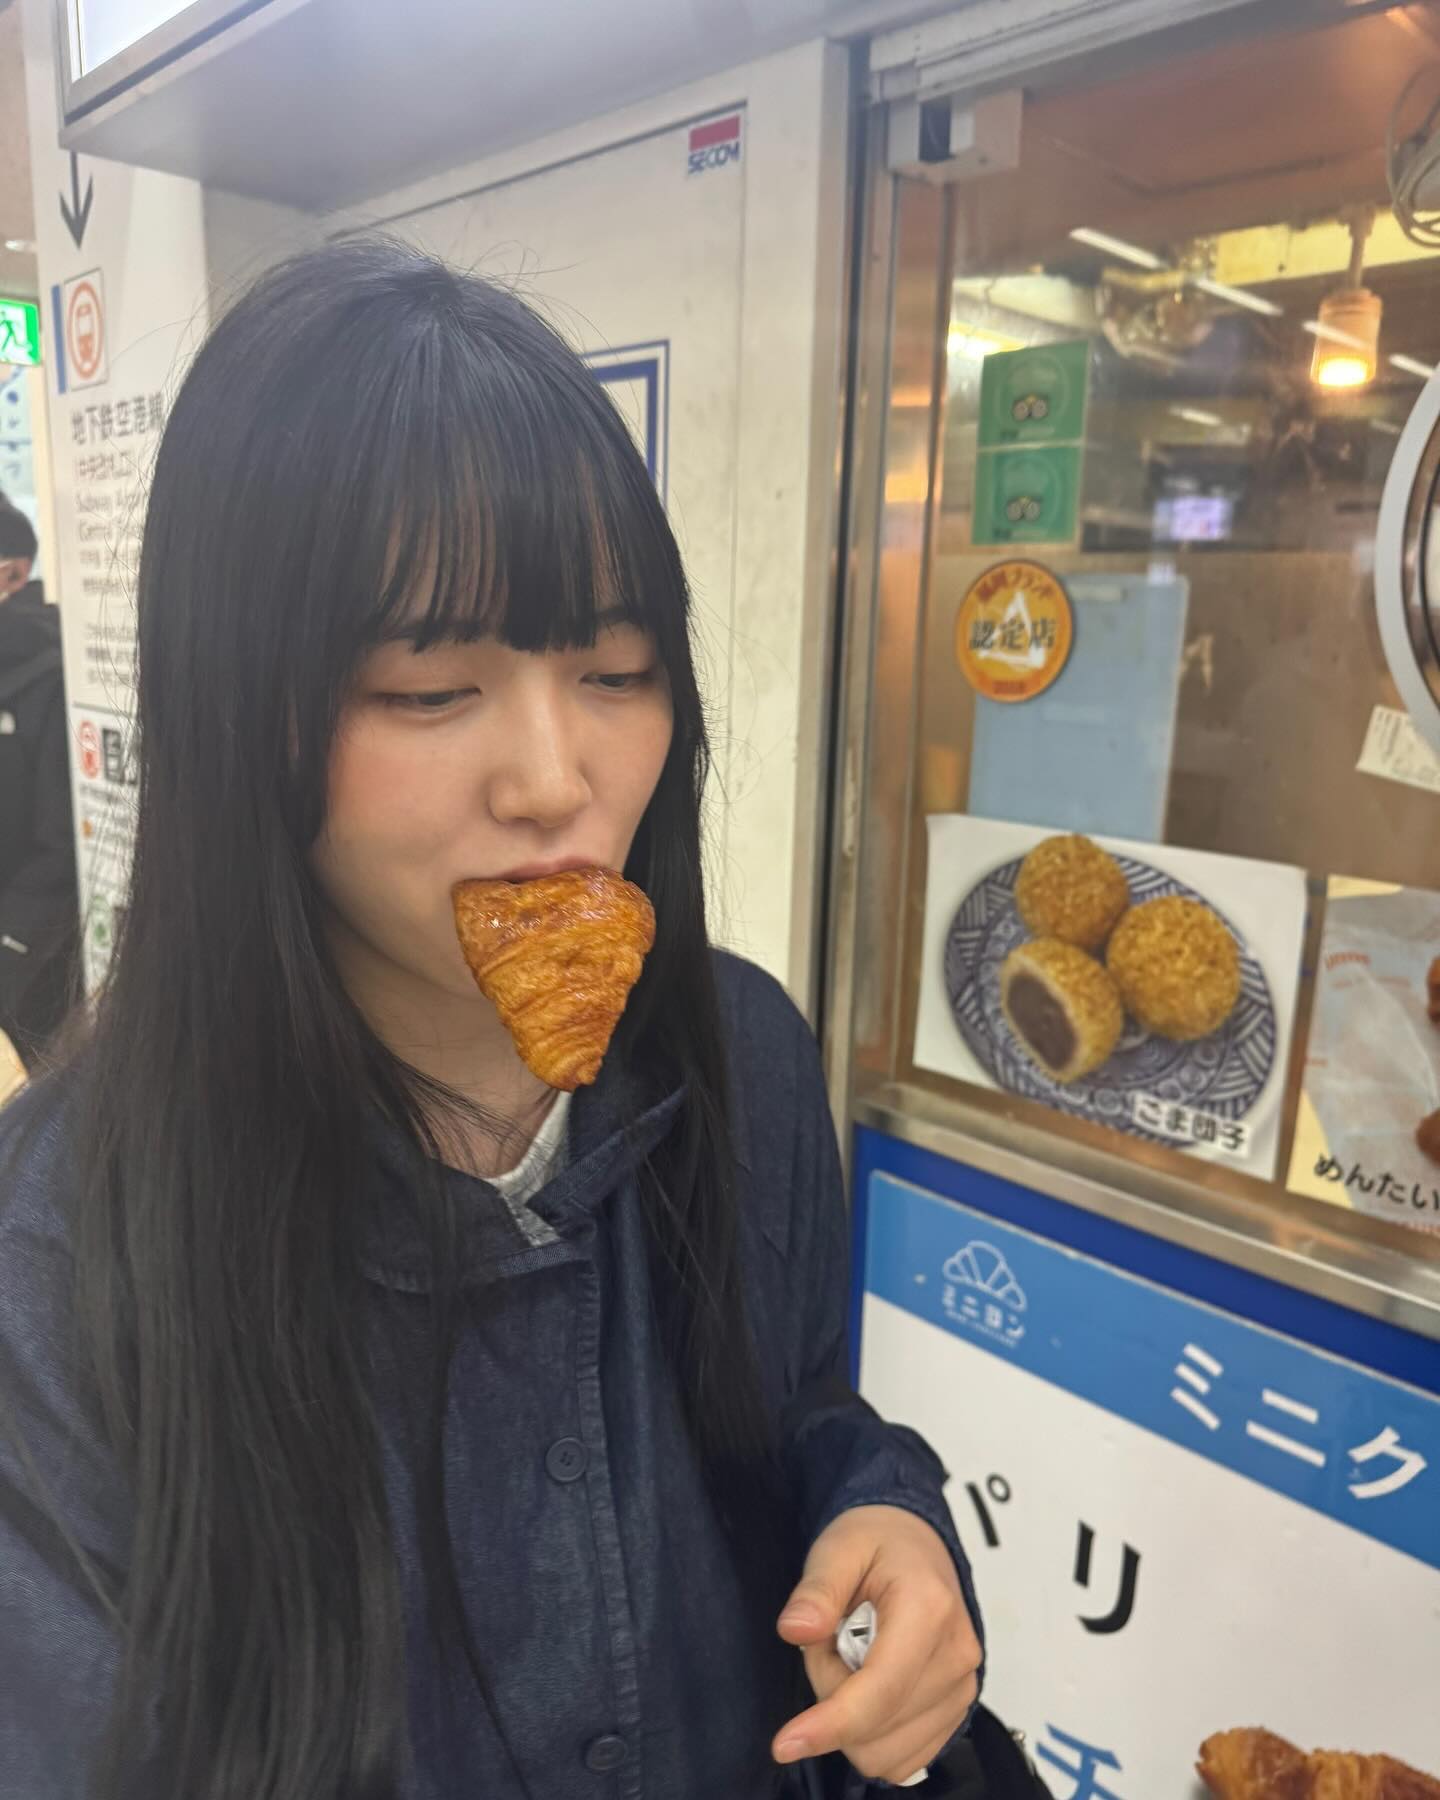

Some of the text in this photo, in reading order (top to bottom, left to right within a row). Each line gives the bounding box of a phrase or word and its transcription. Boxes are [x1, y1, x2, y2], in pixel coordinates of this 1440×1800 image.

[688, 141, 740, 173] SECOM
[971, 617, 1056, 651] 認定店
